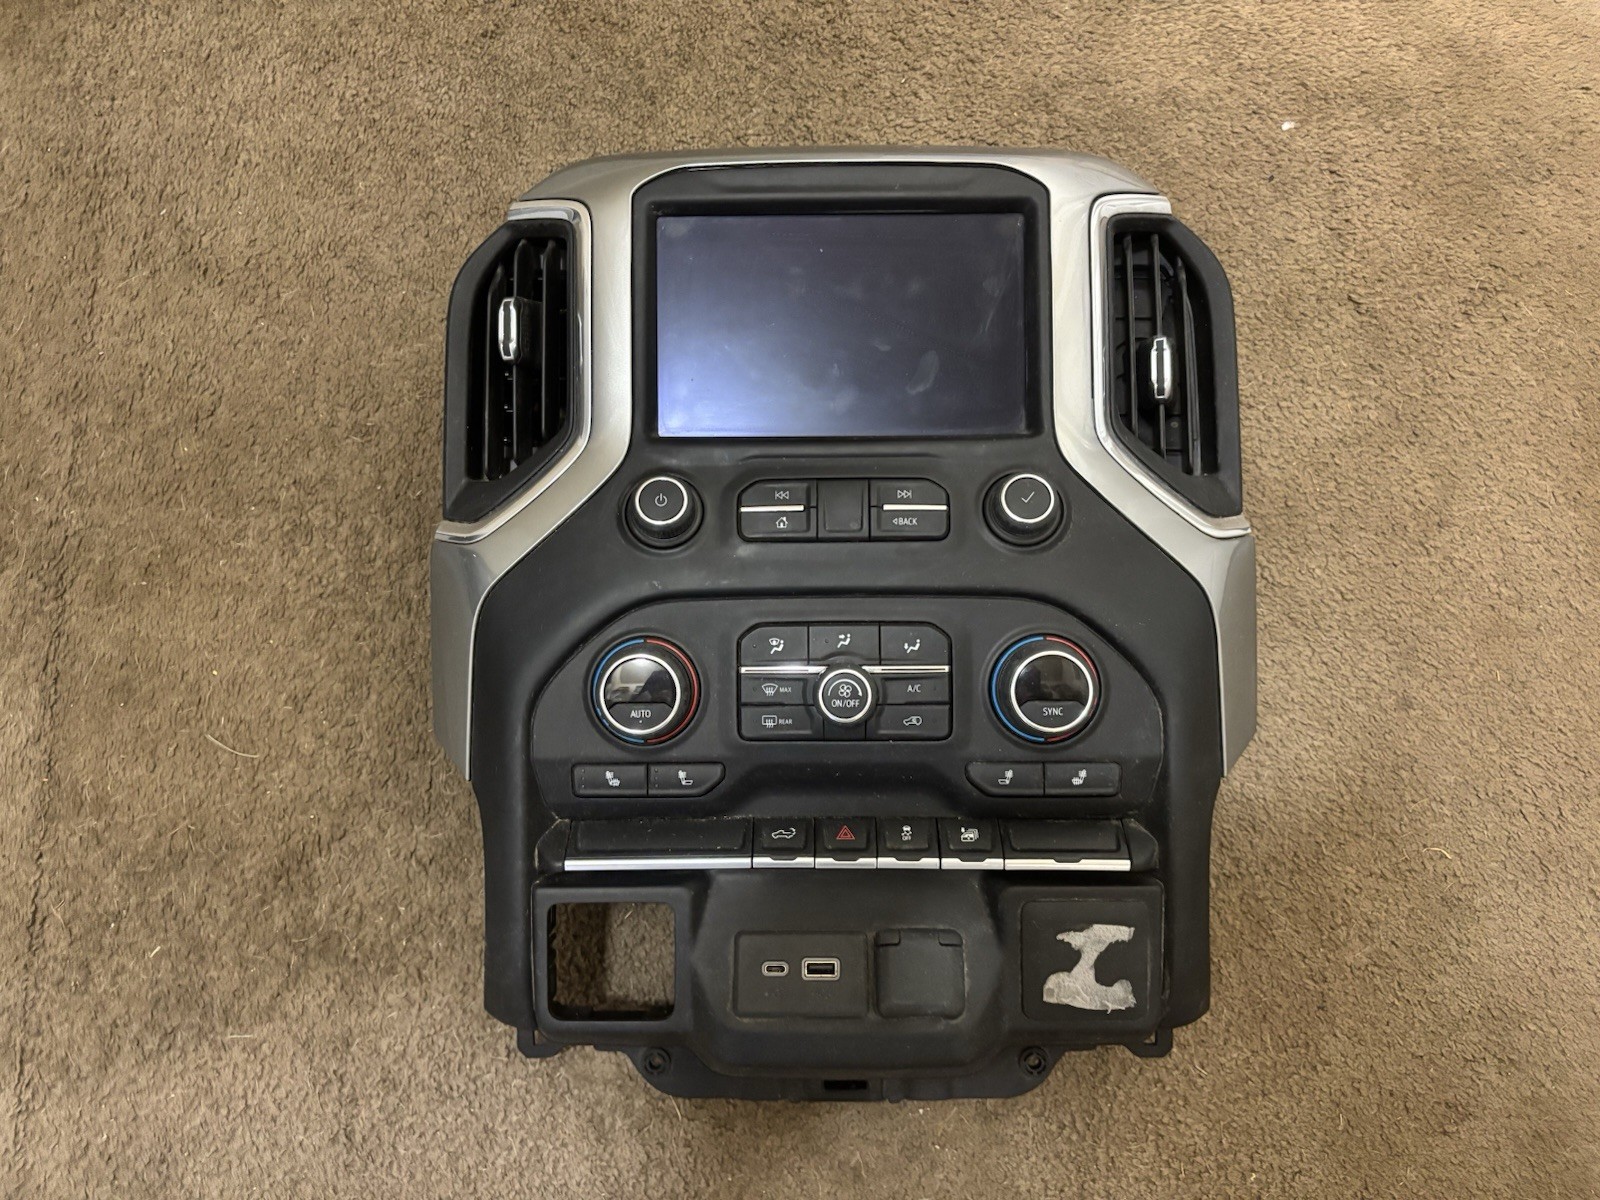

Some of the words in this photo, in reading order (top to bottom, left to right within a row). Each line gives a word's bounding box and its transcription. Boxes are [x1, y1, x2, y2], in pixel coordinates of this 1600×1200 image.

[898, 517, 918, 526] BACK
[906, 683, 921, 693] A/C
[831, 699, 860, 708] ON/OFF
[630, 709, 652, 718] AUTO
[1042, 707, 1064, 716] SYNC
